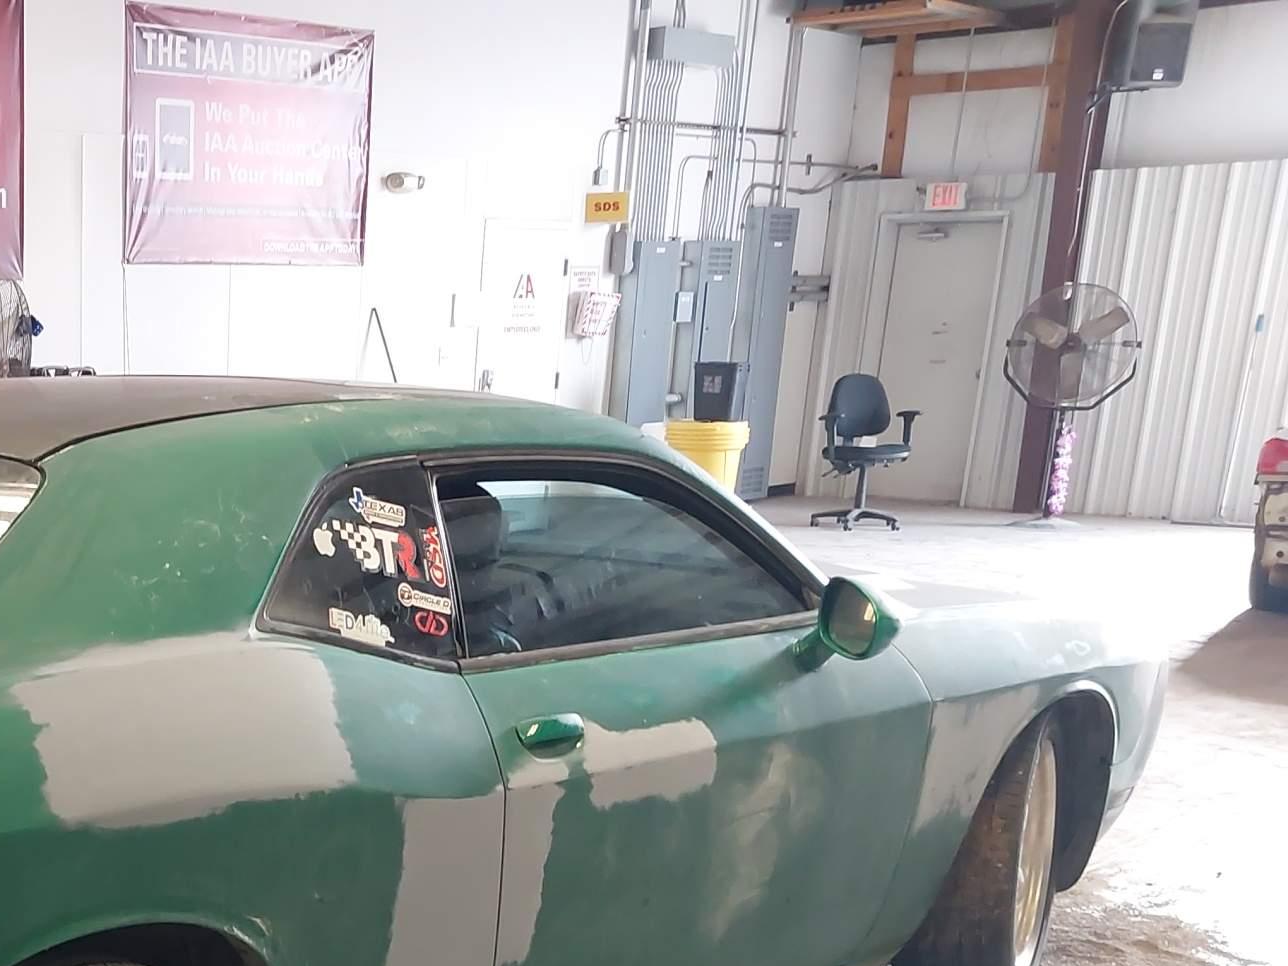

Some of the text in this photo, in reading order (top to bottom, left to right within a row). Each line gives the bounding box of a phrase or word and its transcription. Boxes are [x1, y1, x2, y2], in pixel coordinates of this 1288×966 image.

[142, 31, 188, 69] THE
[194, 38, 235, 73] IAA
[242, 43, 312, 82] BUYER
[205, 102, 233, 123] We
[239, 104, 267, 126] Put
[205, 132, 239, 154] IAA
[204, 161, 221, 183] In
[228, 163, 267, 186] Your
[594, 201, 620, 212] SDS
[932, 184, 960, 207] EXIT
